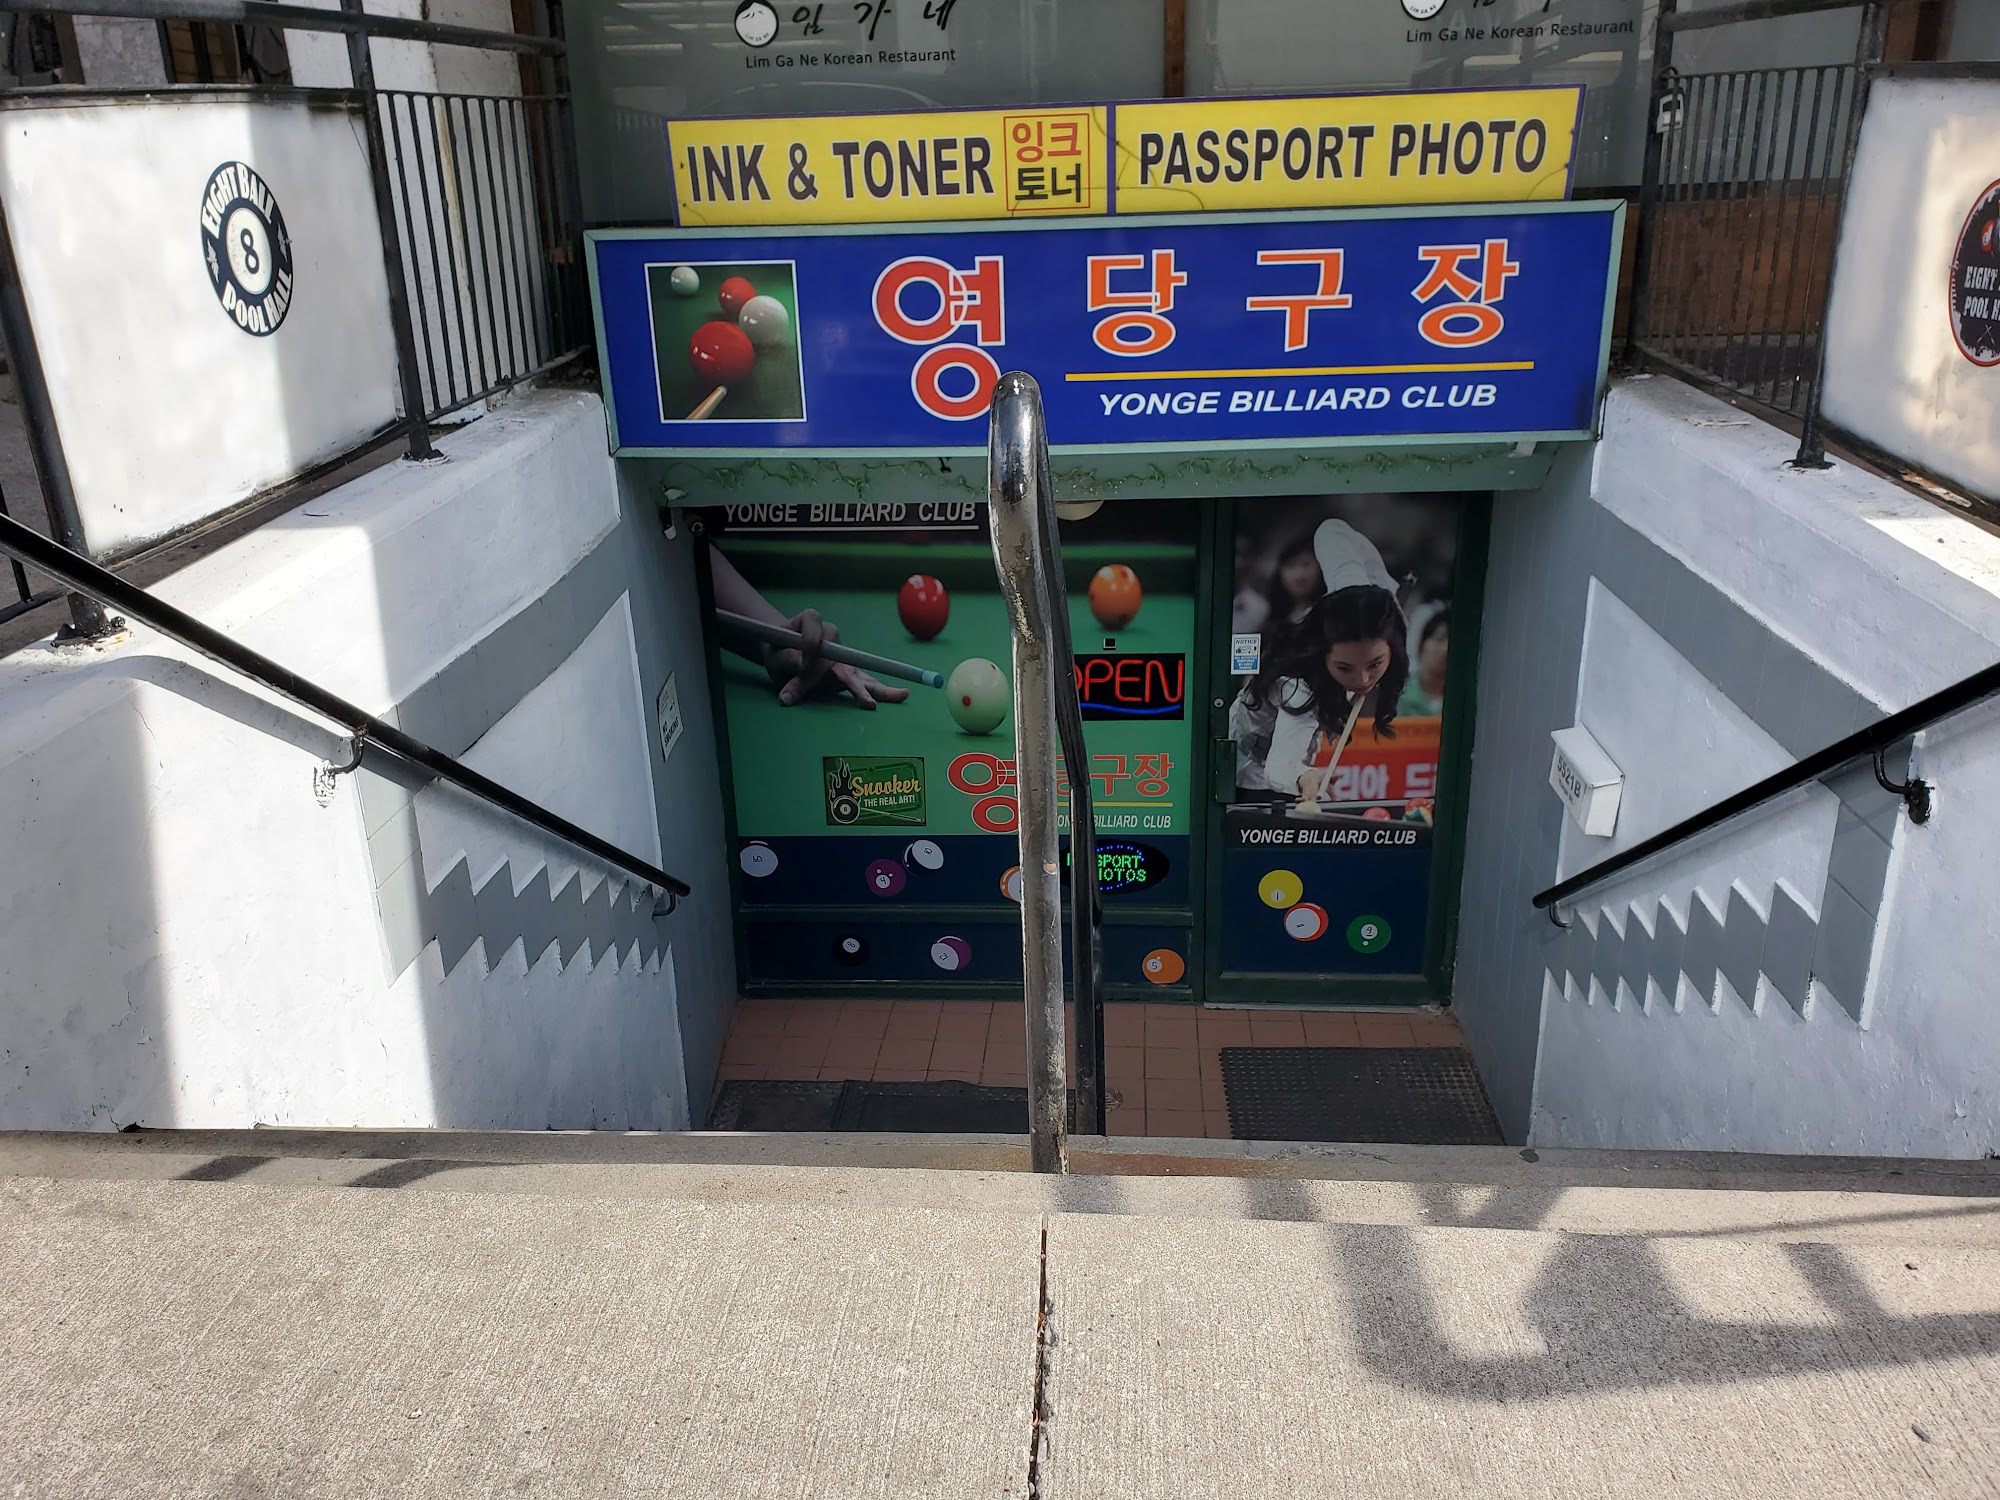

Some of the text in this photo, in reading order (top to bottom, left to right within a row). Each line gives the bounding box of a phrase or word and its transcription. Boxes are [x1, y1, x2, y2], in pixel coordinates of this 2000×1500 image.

[1406, 20, 1634, 42] Lim Ga Ne Korean Restaurant
[746, 49, 956, 69] Lim Ga Ne Korean Restaurant
[1012, 121, 1082, 163] 잉크
[1139, 117, 1549, 186] PASSPORT PHOTO
[686, 136, 996, 203] INK & TONER
[1014, 162, 1083, 204] 토너
[202, 162, 275, 239] EIGHT BALL
[240, 227, 260, 275] 8
[1963, 265, 1998, 291] EIGHT
[222, 267, 293, 333] POOL HALL
[1963, 295, 1989, 319] POOL
[872, 255, 1006, 422] 영
[1099, 382, 1498, 417] YONGE BILLIARD CLUB
[725, 501, 976, 523] YONGE BILLIARD CLUB
[851, 774, 921, 798] Snooker
[1328, 764, 1390, 801] 리아
[1557, 754, 1582, 799] 5521B
[864, 794, 915, 808] THE REAL ART!
[1143, 814, 1171, 828] CLUB
[1240, 829, 1417, 845] YONGE BILLIARD CLUB
[880, 875, 887, 885] 4
[1151, 961, 1158, 970] 5
